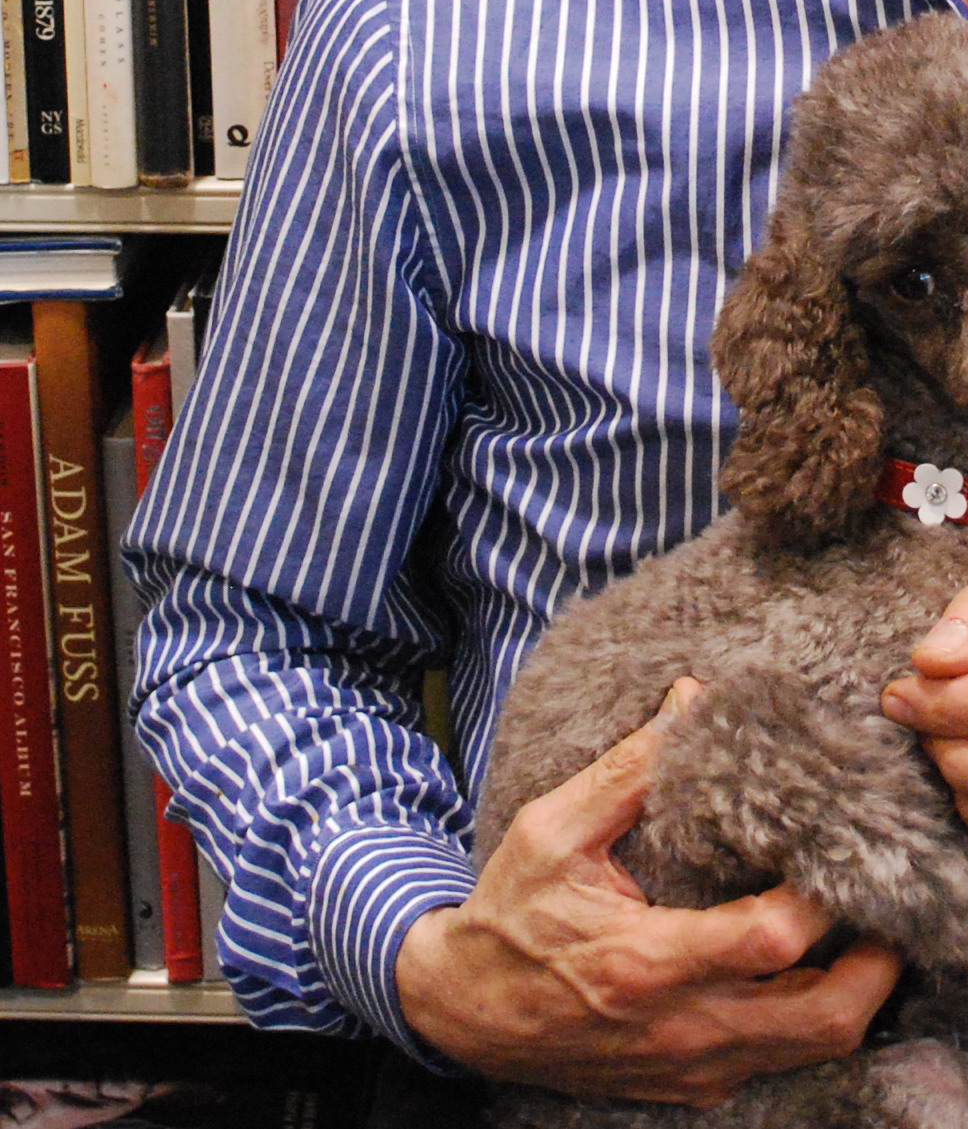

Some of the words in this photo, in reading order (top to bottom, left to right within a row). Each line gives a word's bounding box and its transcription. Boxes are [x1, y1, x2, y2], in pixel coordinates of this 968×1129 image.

[41, 109, 63, 123] NY
[41, 122, 63, 136] GS
[1, 512, 16, 558] SAN
[48, 452, 93, 586] ADAM
[5, 569, 27, 706] FRANCISCO
[58, 603, 100, 703] FUSS
[13, 715, 33, 798] ALBUM
